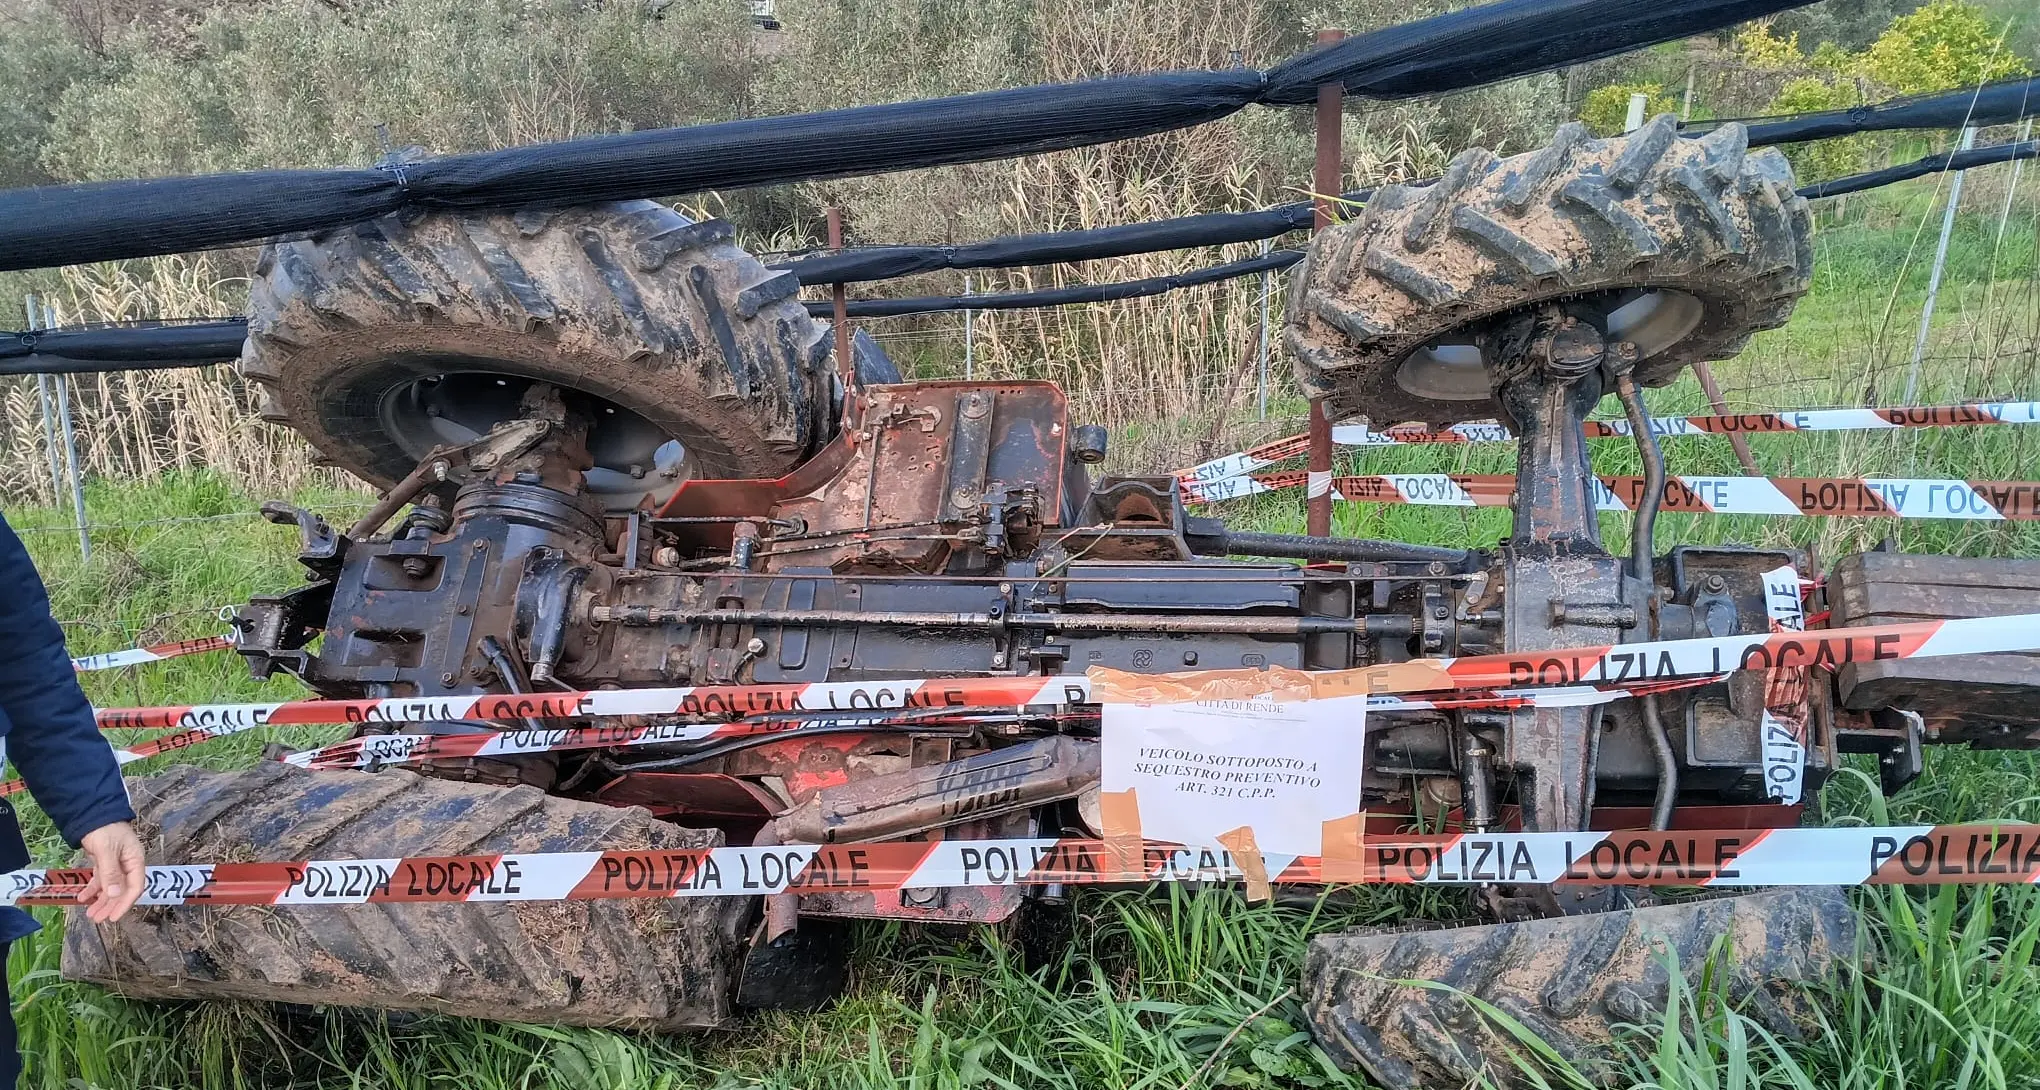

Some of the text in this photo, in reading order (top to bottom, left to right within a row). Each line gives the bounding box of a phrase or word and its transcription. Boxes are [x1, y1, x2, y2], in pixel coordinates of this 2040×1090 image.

[1246, 702, 1285, 714] RENDE
[1134, 762, 1322, 789] SEQUESTRO PREVENTIVO
[1138, 747, 1318, 773] VEICOLO SOTTOPOSTO A
[1175, 781, 1276, 799] ART. 321 C.P.P.
[601, 849, 870, 892] POLIZIA LOCALE
[960, 845, 1099, 885] POLIZIA
[1377, 837, 1741, 882] POLIZIA LOCALE
[284, 860, 522, 898] POLIZIA LOCALE
